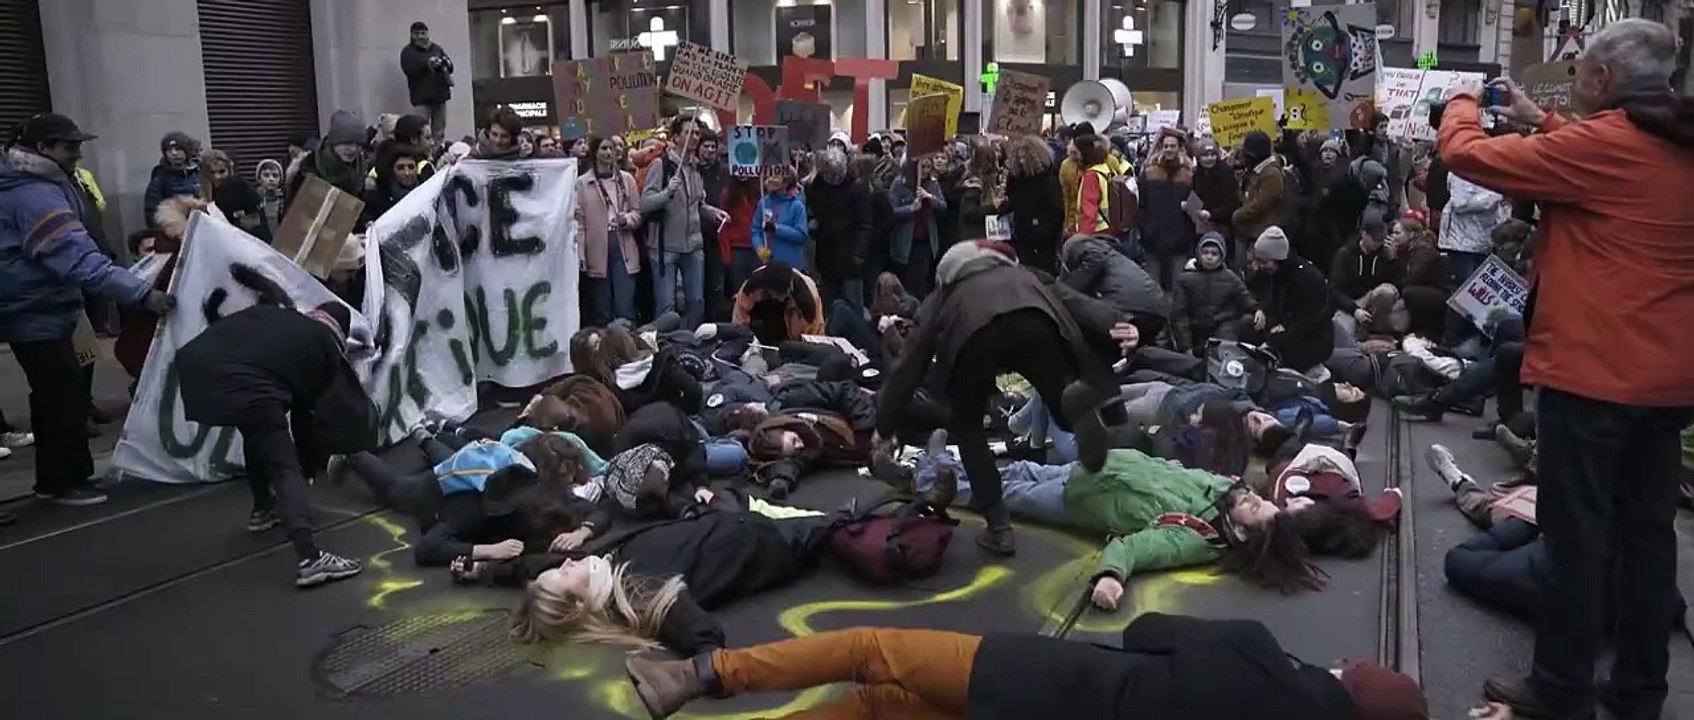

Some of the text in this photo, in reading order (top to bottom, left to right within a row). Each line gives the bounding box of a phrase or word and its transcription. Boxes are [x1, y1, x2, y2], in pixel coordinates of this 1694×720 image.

[679, 41, 693, 50] ON
[672, 75, 733, 106] ON AGIT
[1386, 88, 1418, 98] THAT
[734, 126, 776, 139] STOP
[732, 164, 790, 176] POLLUTION
